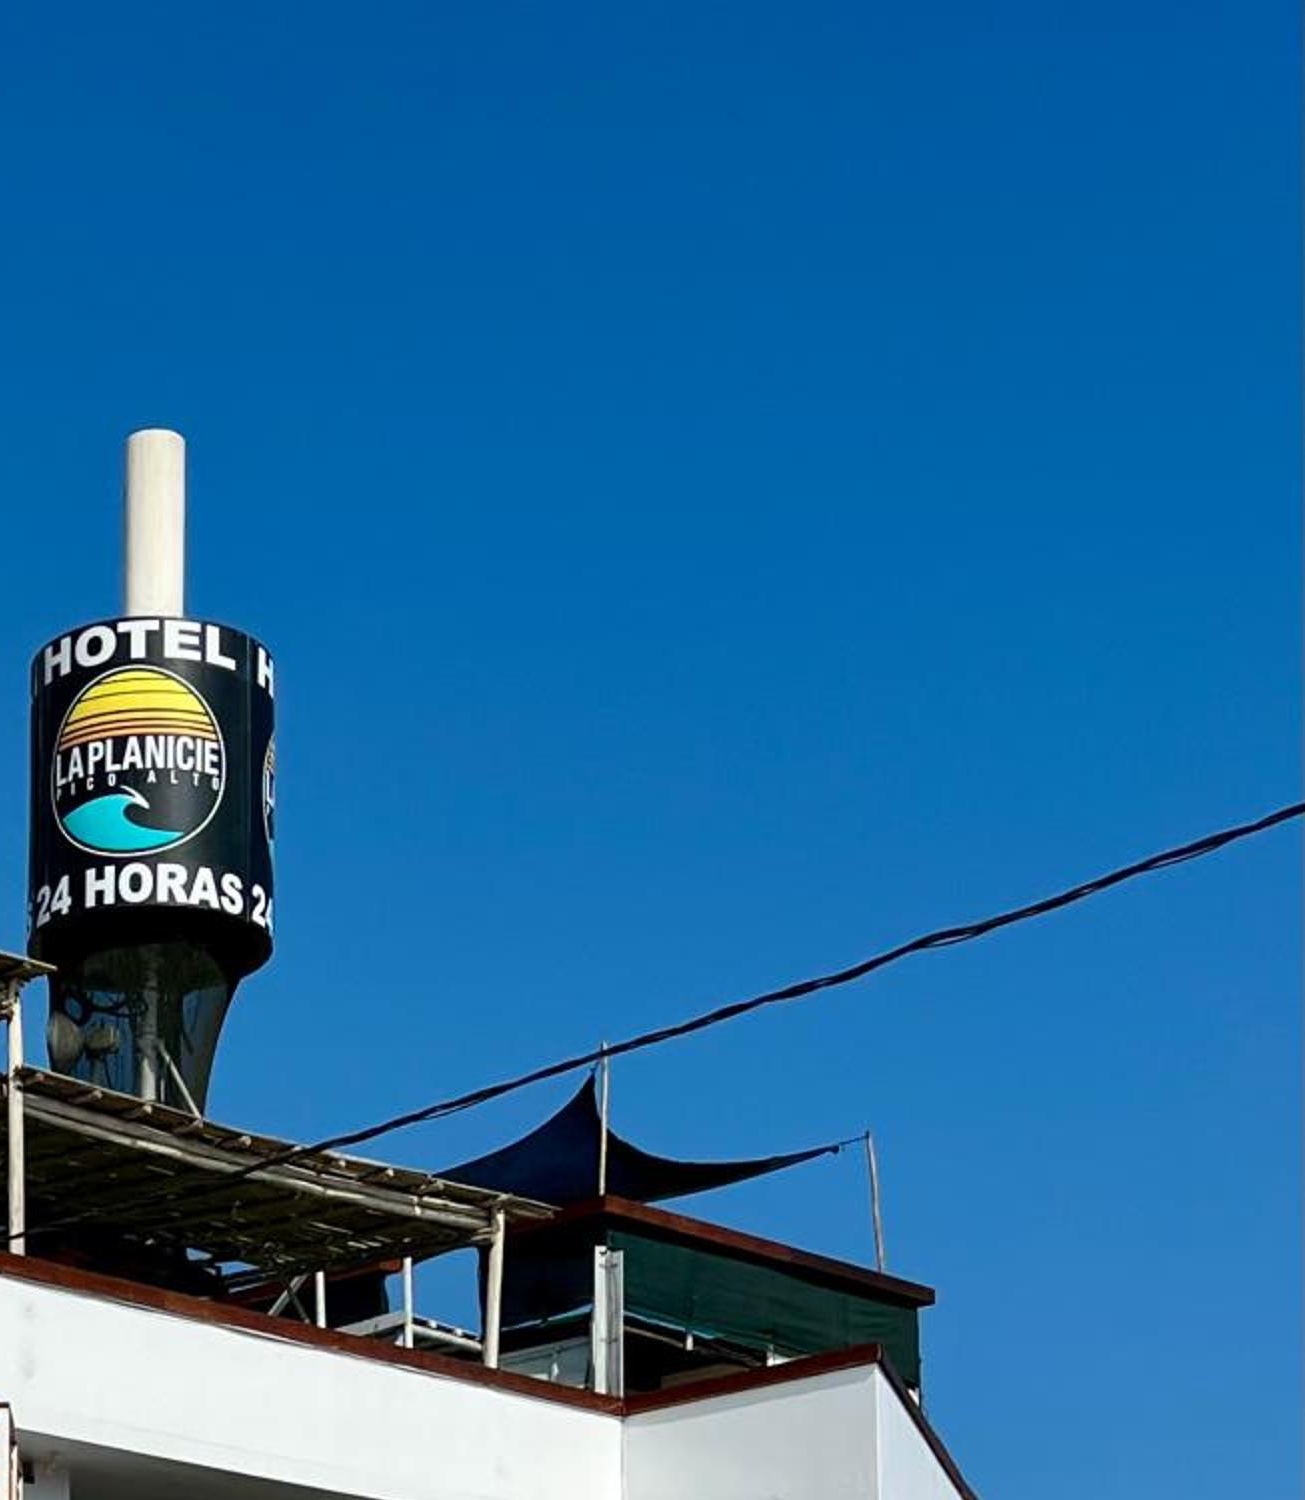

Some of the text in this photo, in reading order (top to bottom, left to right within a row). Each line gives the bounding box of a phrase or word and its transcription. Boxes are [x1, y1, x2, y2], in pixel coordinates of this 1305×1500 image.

[45, 619, 236, 686] HOTEL
[147, 769, 220, 791] ALTO
[36, 874, 72, 928] 24
[85, 862, 244, 915] HORAS
